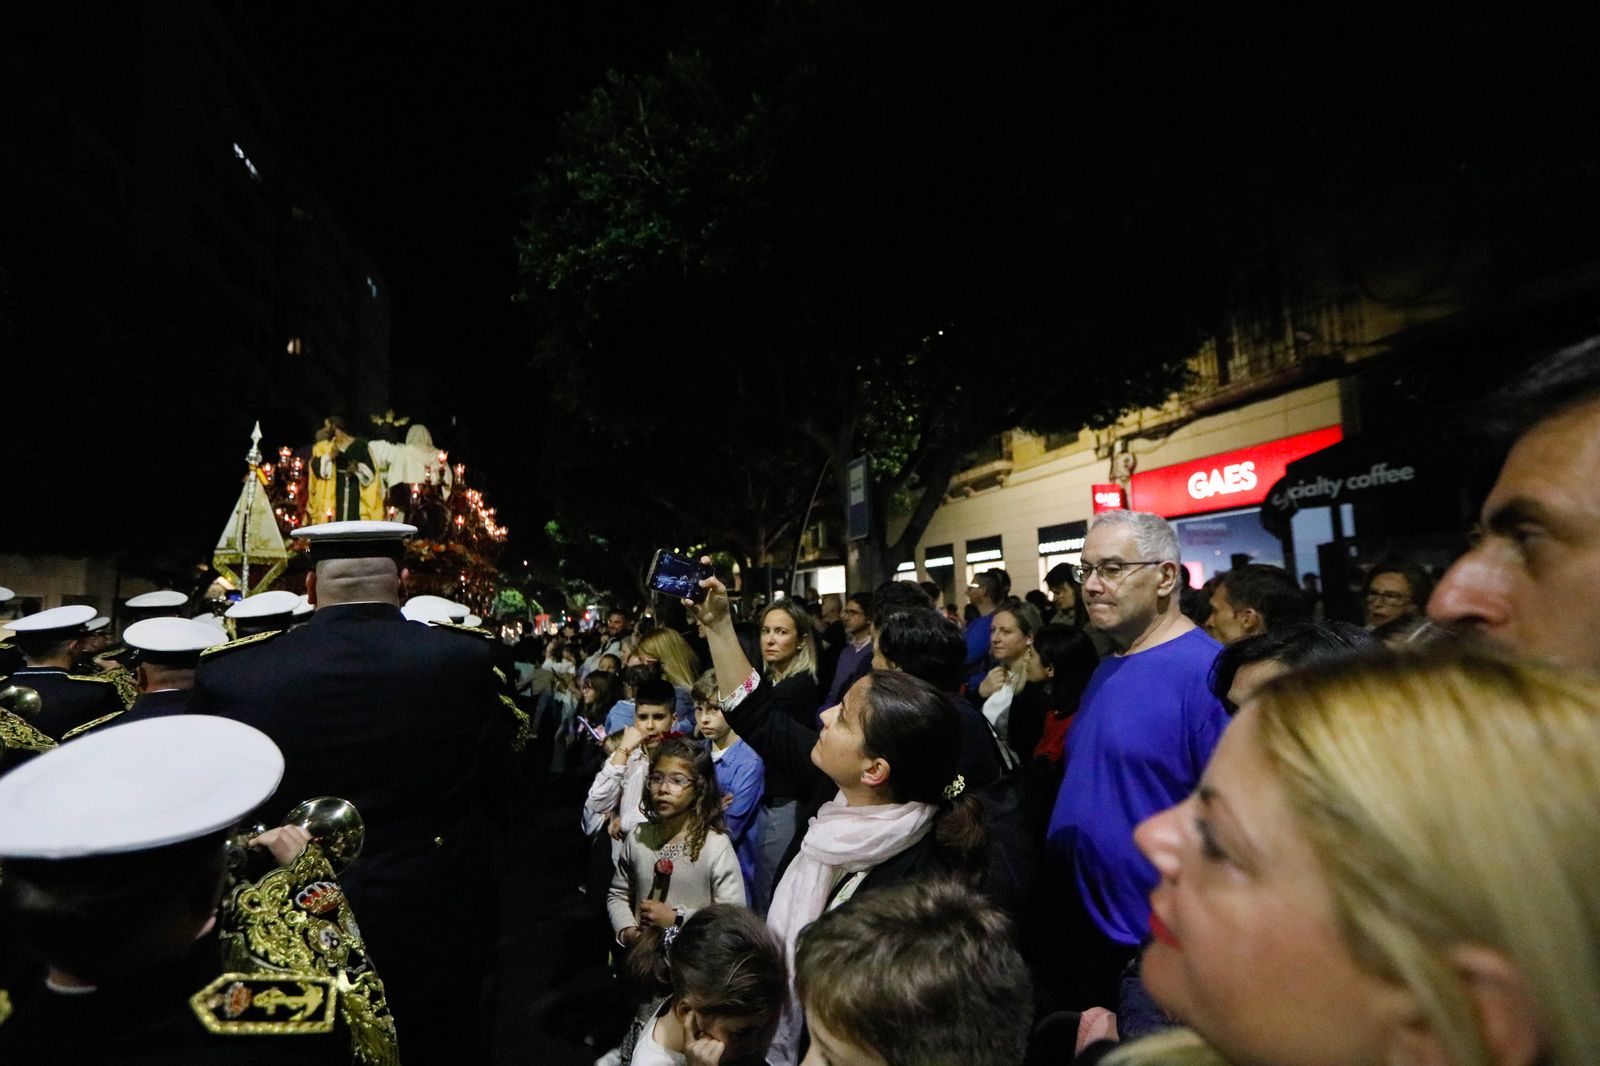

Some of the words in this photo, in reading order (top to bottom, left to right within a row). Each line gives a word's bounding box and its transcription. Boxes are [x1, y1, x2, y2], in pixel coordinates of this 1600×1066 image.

[1187, 461, 1258, 500] GAES
[1272, 475, 1344, 511] scialty
[1346, 462, 1416, 490] coffee
